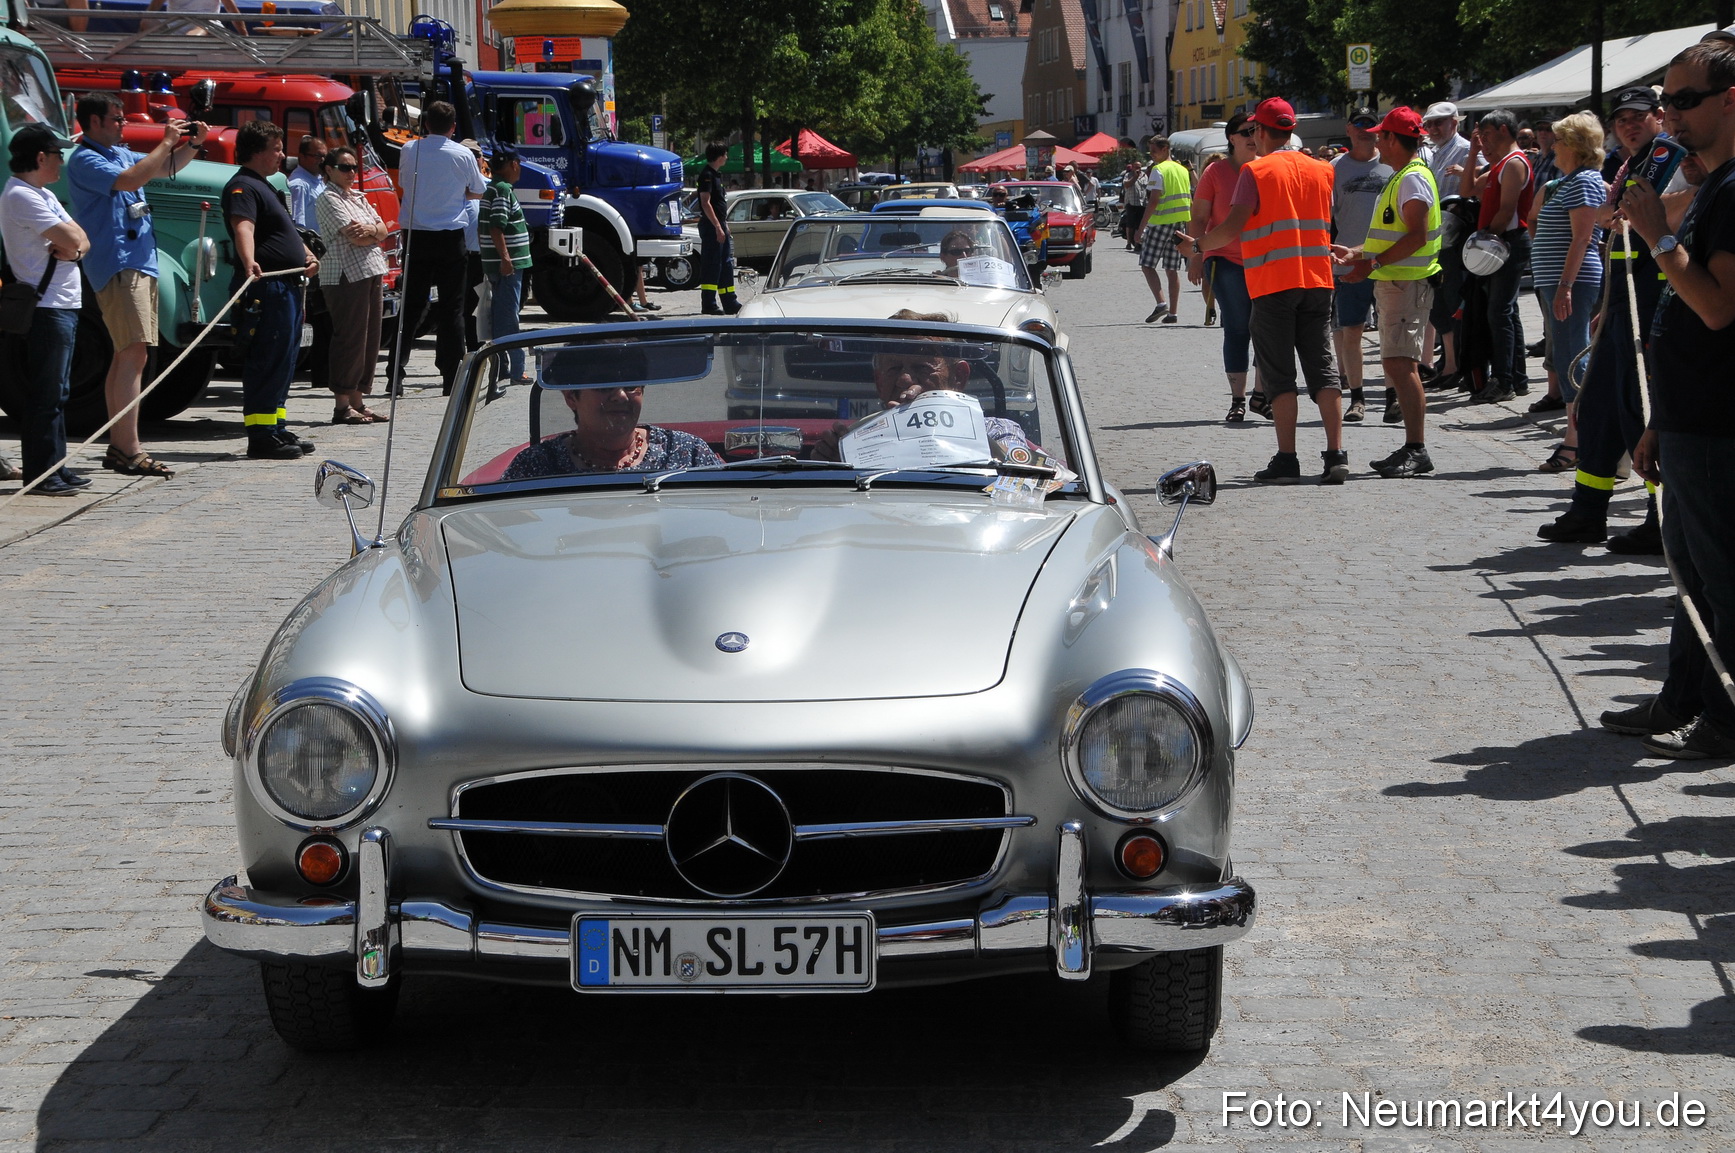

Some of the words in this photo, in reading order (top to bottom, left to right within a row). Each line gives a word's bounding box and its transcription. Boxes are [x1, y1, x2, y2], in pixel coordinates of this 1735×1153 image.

[165, 182, 192, 191] Baujahr
[195, 184, 212, 192] 1952
[984, 261, 1003, 271] 235
[906, 410, 955, 429] 480
[612, 927, 671, 977] NM
[589, 959, 600, 973] D
